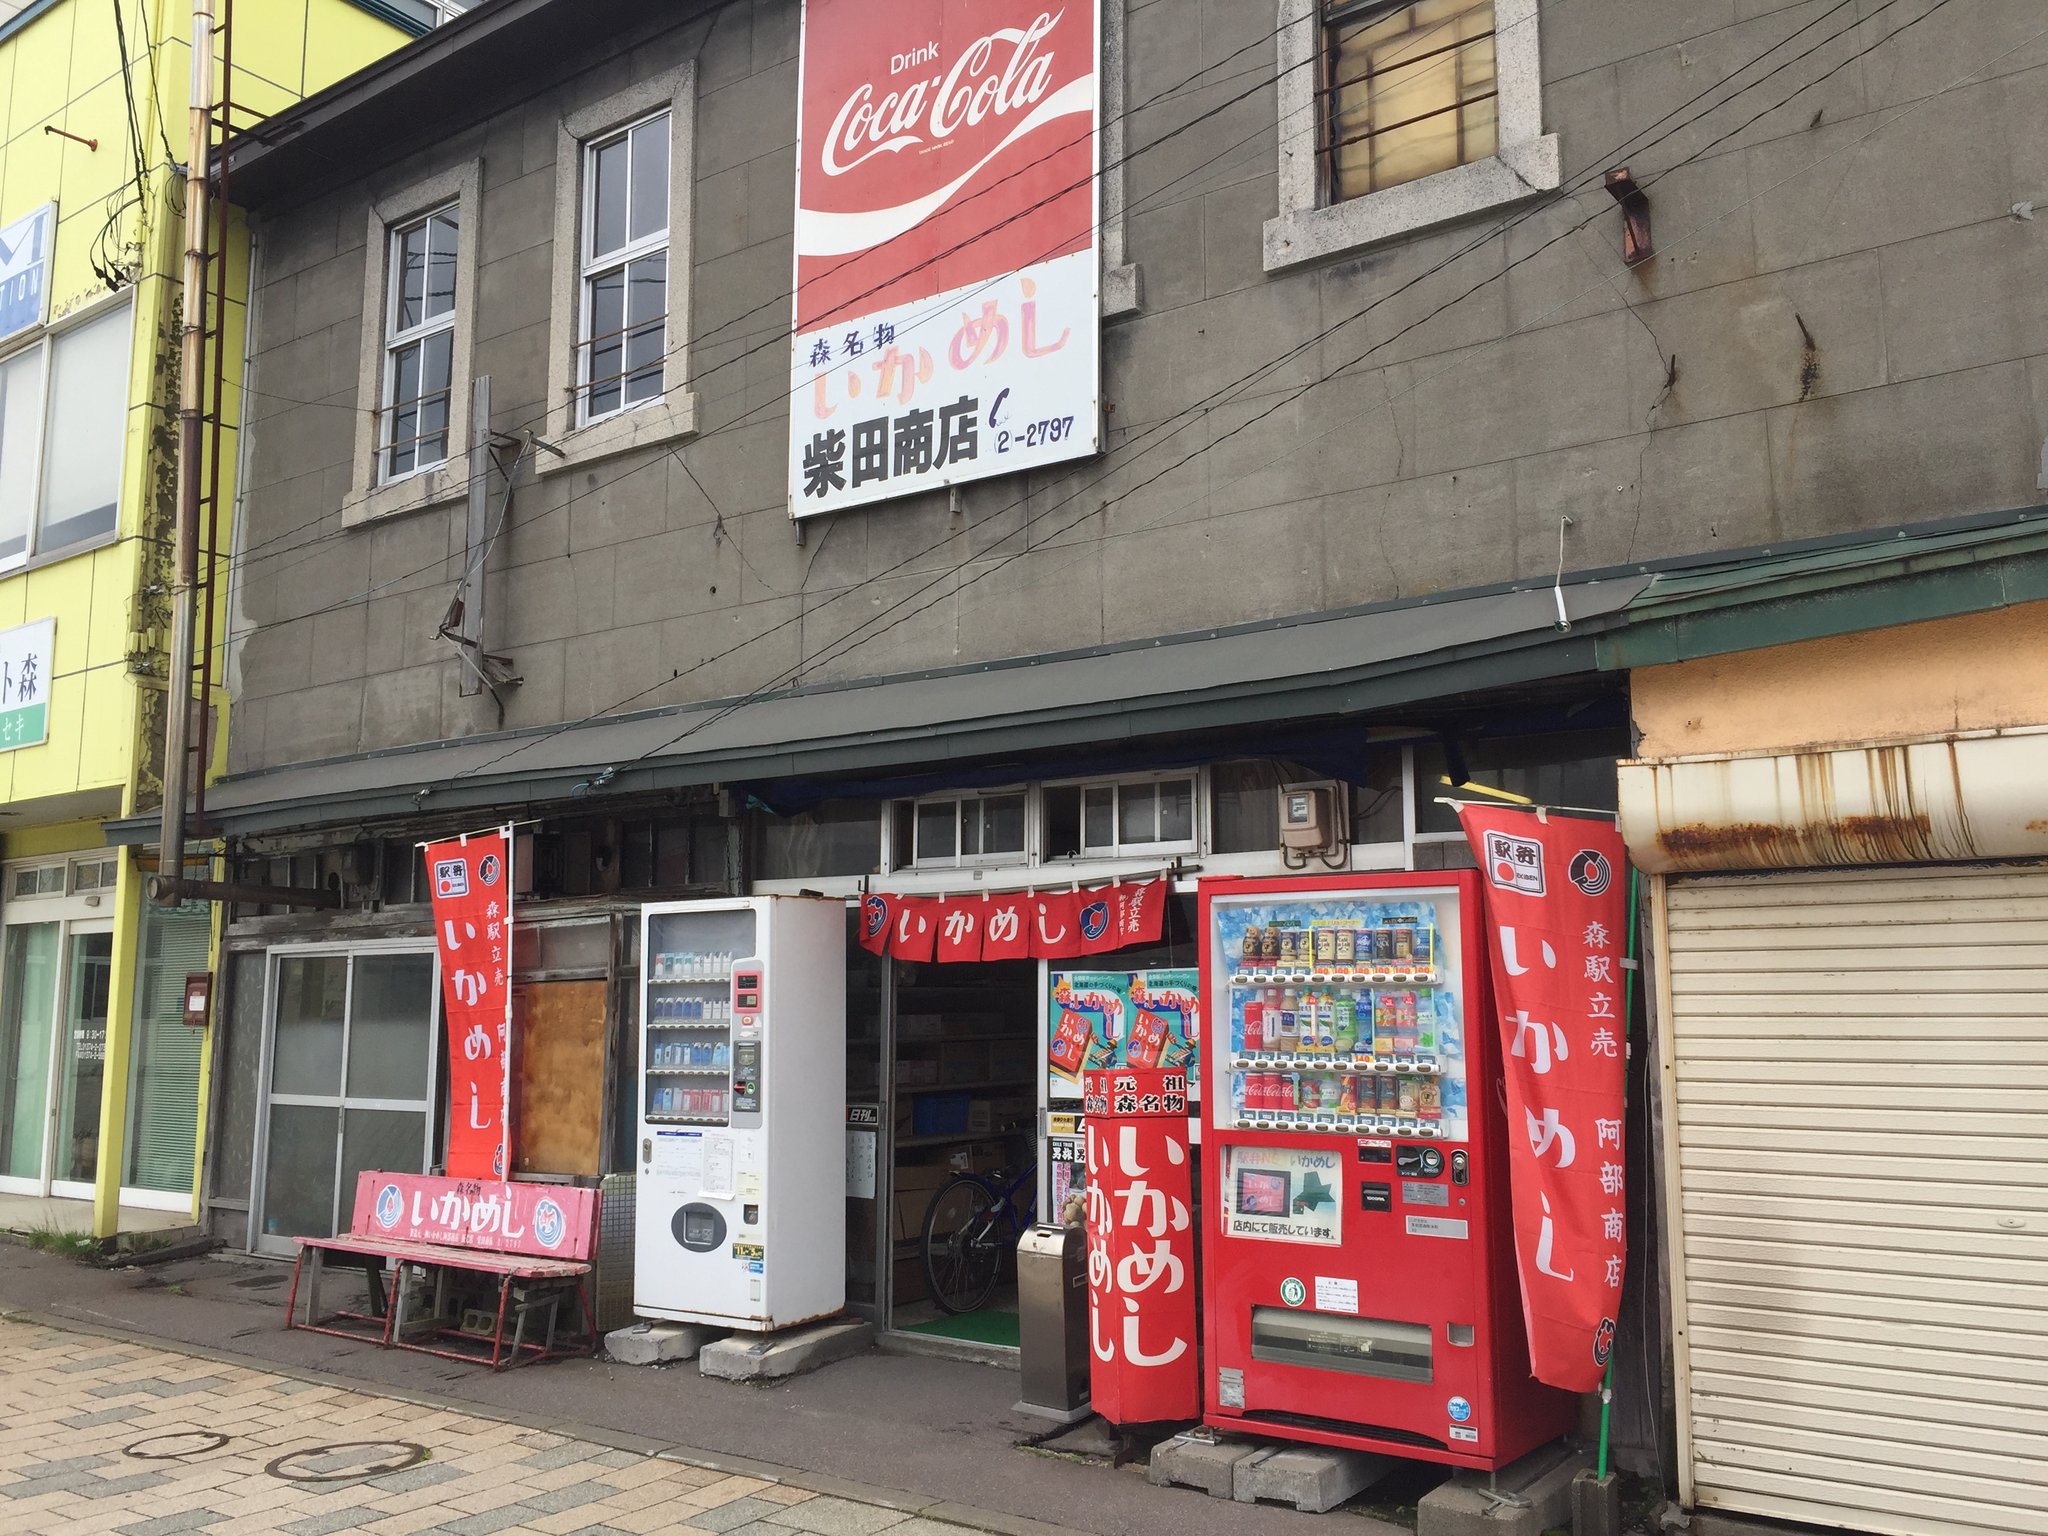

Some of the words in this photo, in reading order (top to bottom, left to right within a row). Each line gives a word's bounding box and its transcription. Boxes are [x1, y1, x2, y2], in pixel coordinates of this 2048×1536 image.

[821, 7, 1065, 177] Coca-Cola
[891, 40, 940, 76] Drink
[809, 323, 895, 367] 森名物
[814, 278, 1071, 420] いかめし
[803, 395, 979, 499] 柴田商店
[486, 901, 504, 986] 森駅立売
[899, 903, 1067, 944] いかめし
[445, 919, 492, 1130] いかめし
[1582, 921, 1619, 1058] 森駅立売
[849, 1109, 872, 1122] 日刊
[1114, 1094, 1185, 1113] 森名物
[1500, 924, 1575, 1281] いかめし
[1290, 1155, 1336, 1168] いかめし
[1596, 1117, 1624, 1289] 阿部商店
[411, 1185, 526, 1239] いかめし
[1086, 1125, 1115, 1363] いかめし
[1114, 1125, 1190, 1367] いかめし
[1233, 1220, 1336, 1239] 店内にて販売しています。
